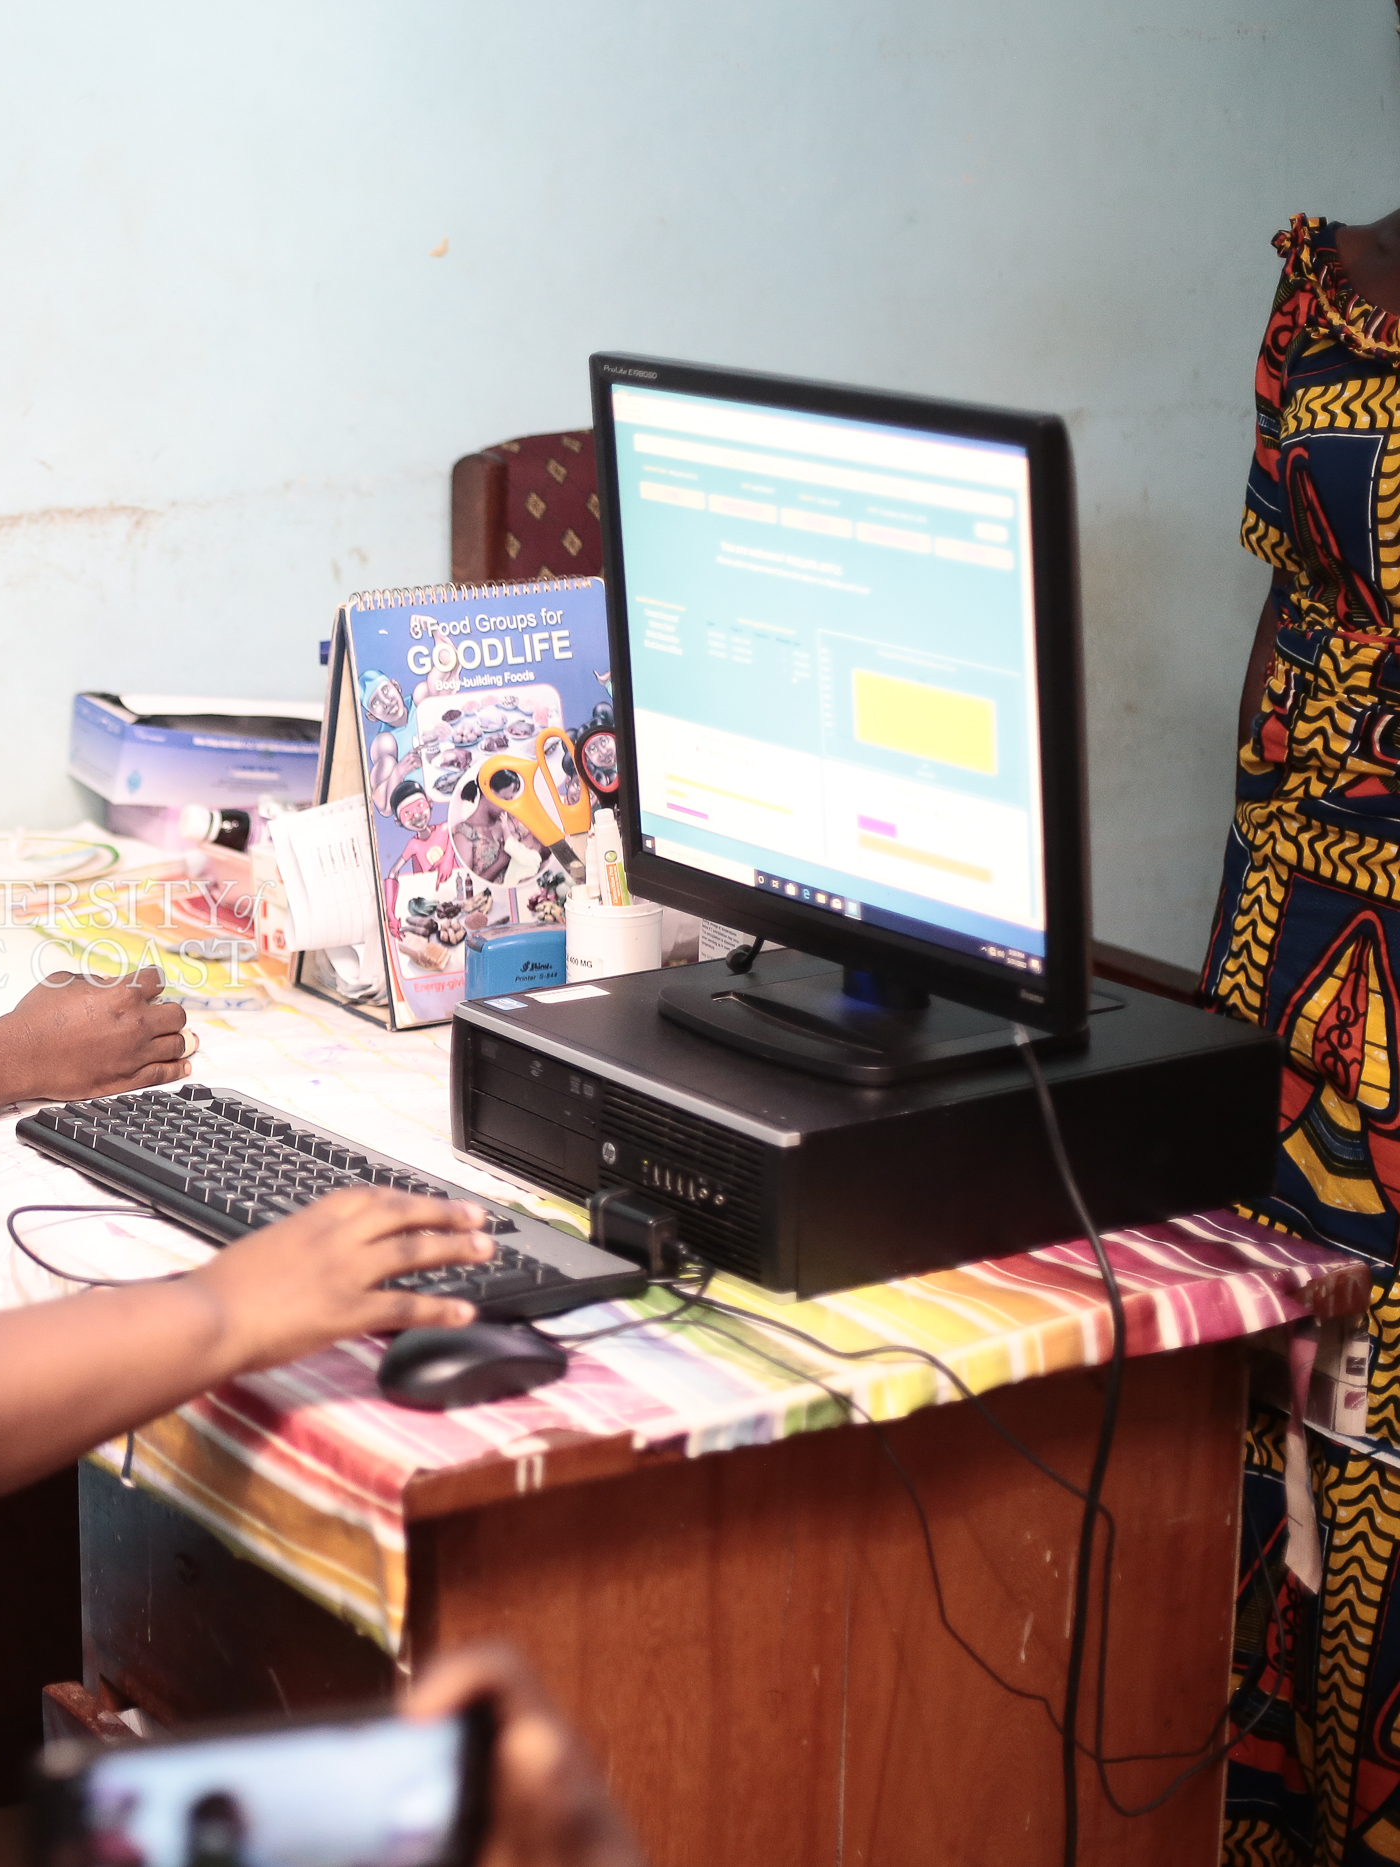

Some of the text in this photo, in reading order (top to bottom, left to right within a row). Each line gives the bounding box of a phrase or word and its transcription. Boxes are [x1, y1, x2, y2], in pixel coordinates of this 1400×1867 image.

[411, 607, 564, 640] 3 Food Groups for
[406, 629, 574, 676] GOODLIFE
[435, 670, 536, 692] Body-building Foods
[569, 957, 579, 966] 400
[579, 959, 593, 969] MG
[515, 975, 536, 983] Printer
